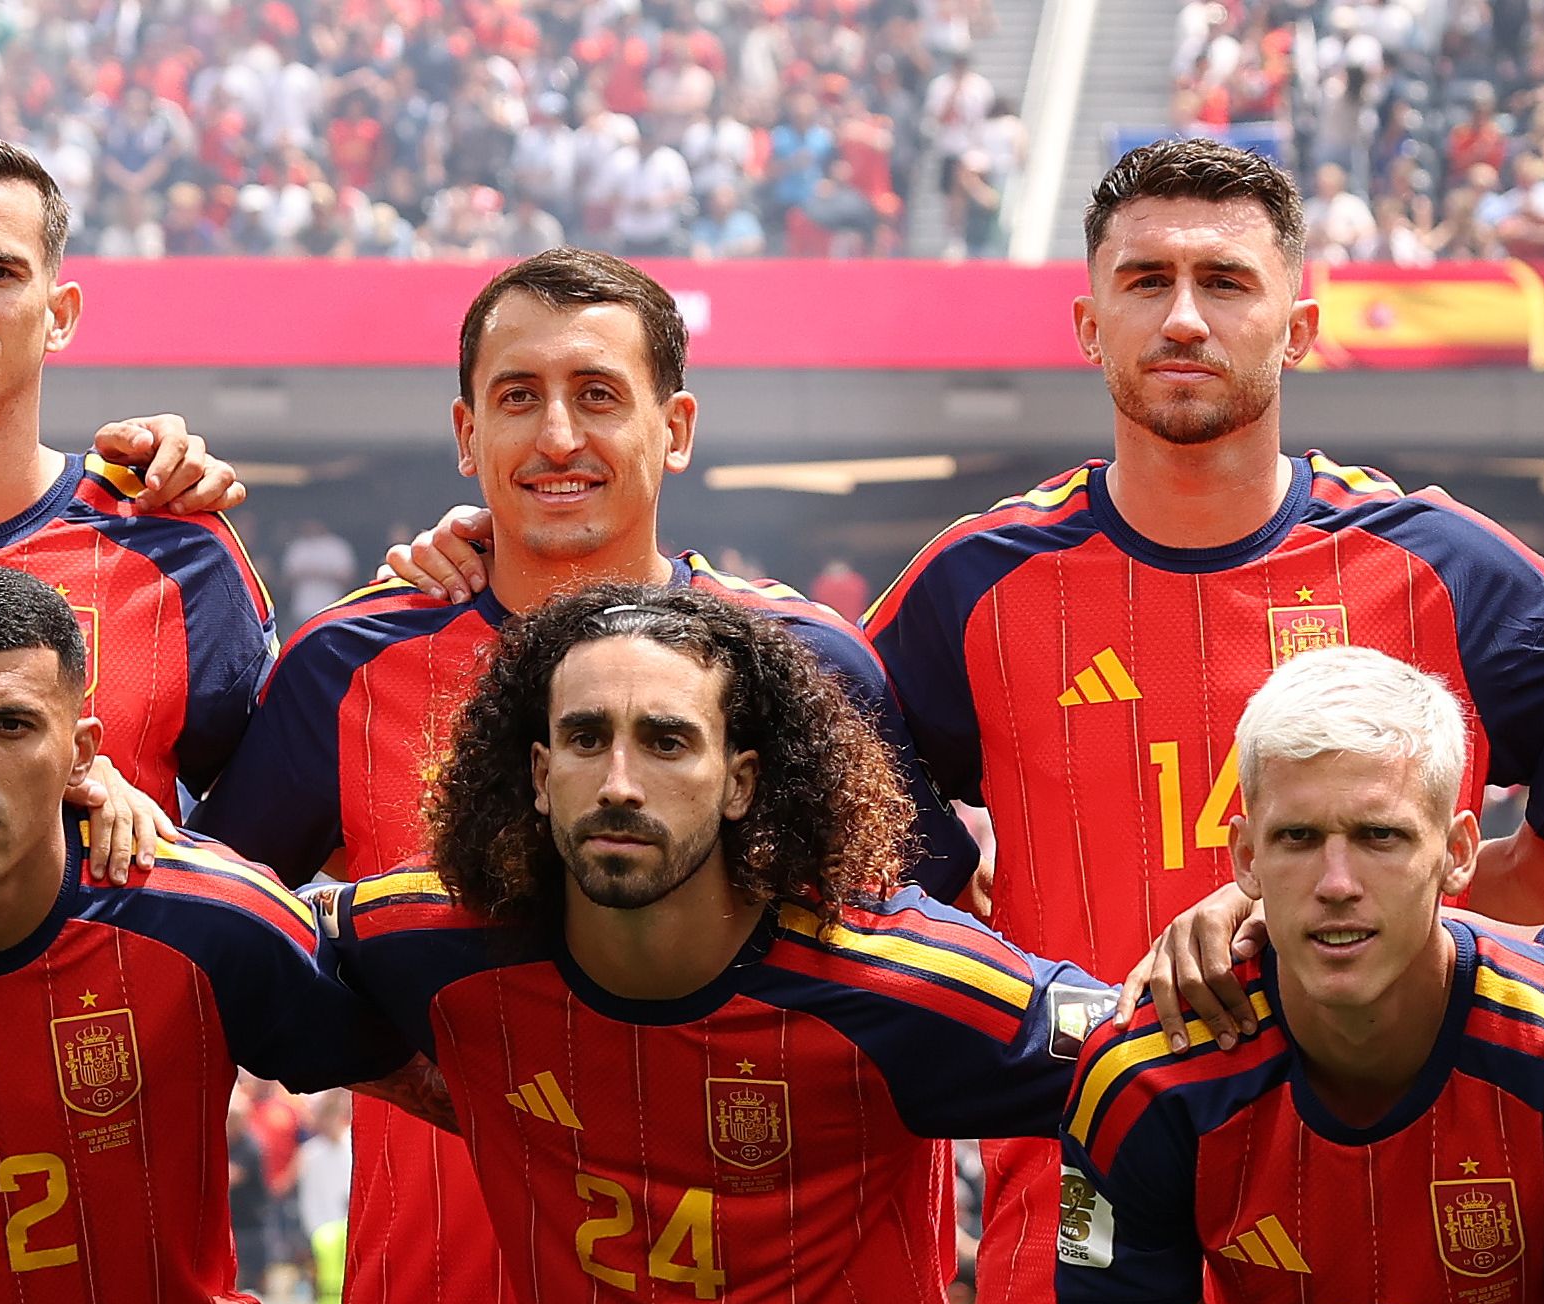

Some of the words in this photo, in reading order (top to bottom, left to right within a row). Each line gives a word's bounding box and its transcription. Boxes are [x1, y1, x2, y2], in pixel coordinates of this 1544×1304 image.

[1147, 740, 1242, 871] 14
[574, 1172, 726, 1300] 24
[1060, 1247, 1089, 1260] 026
[1062, 1225, 1080, 1237] FIFA
